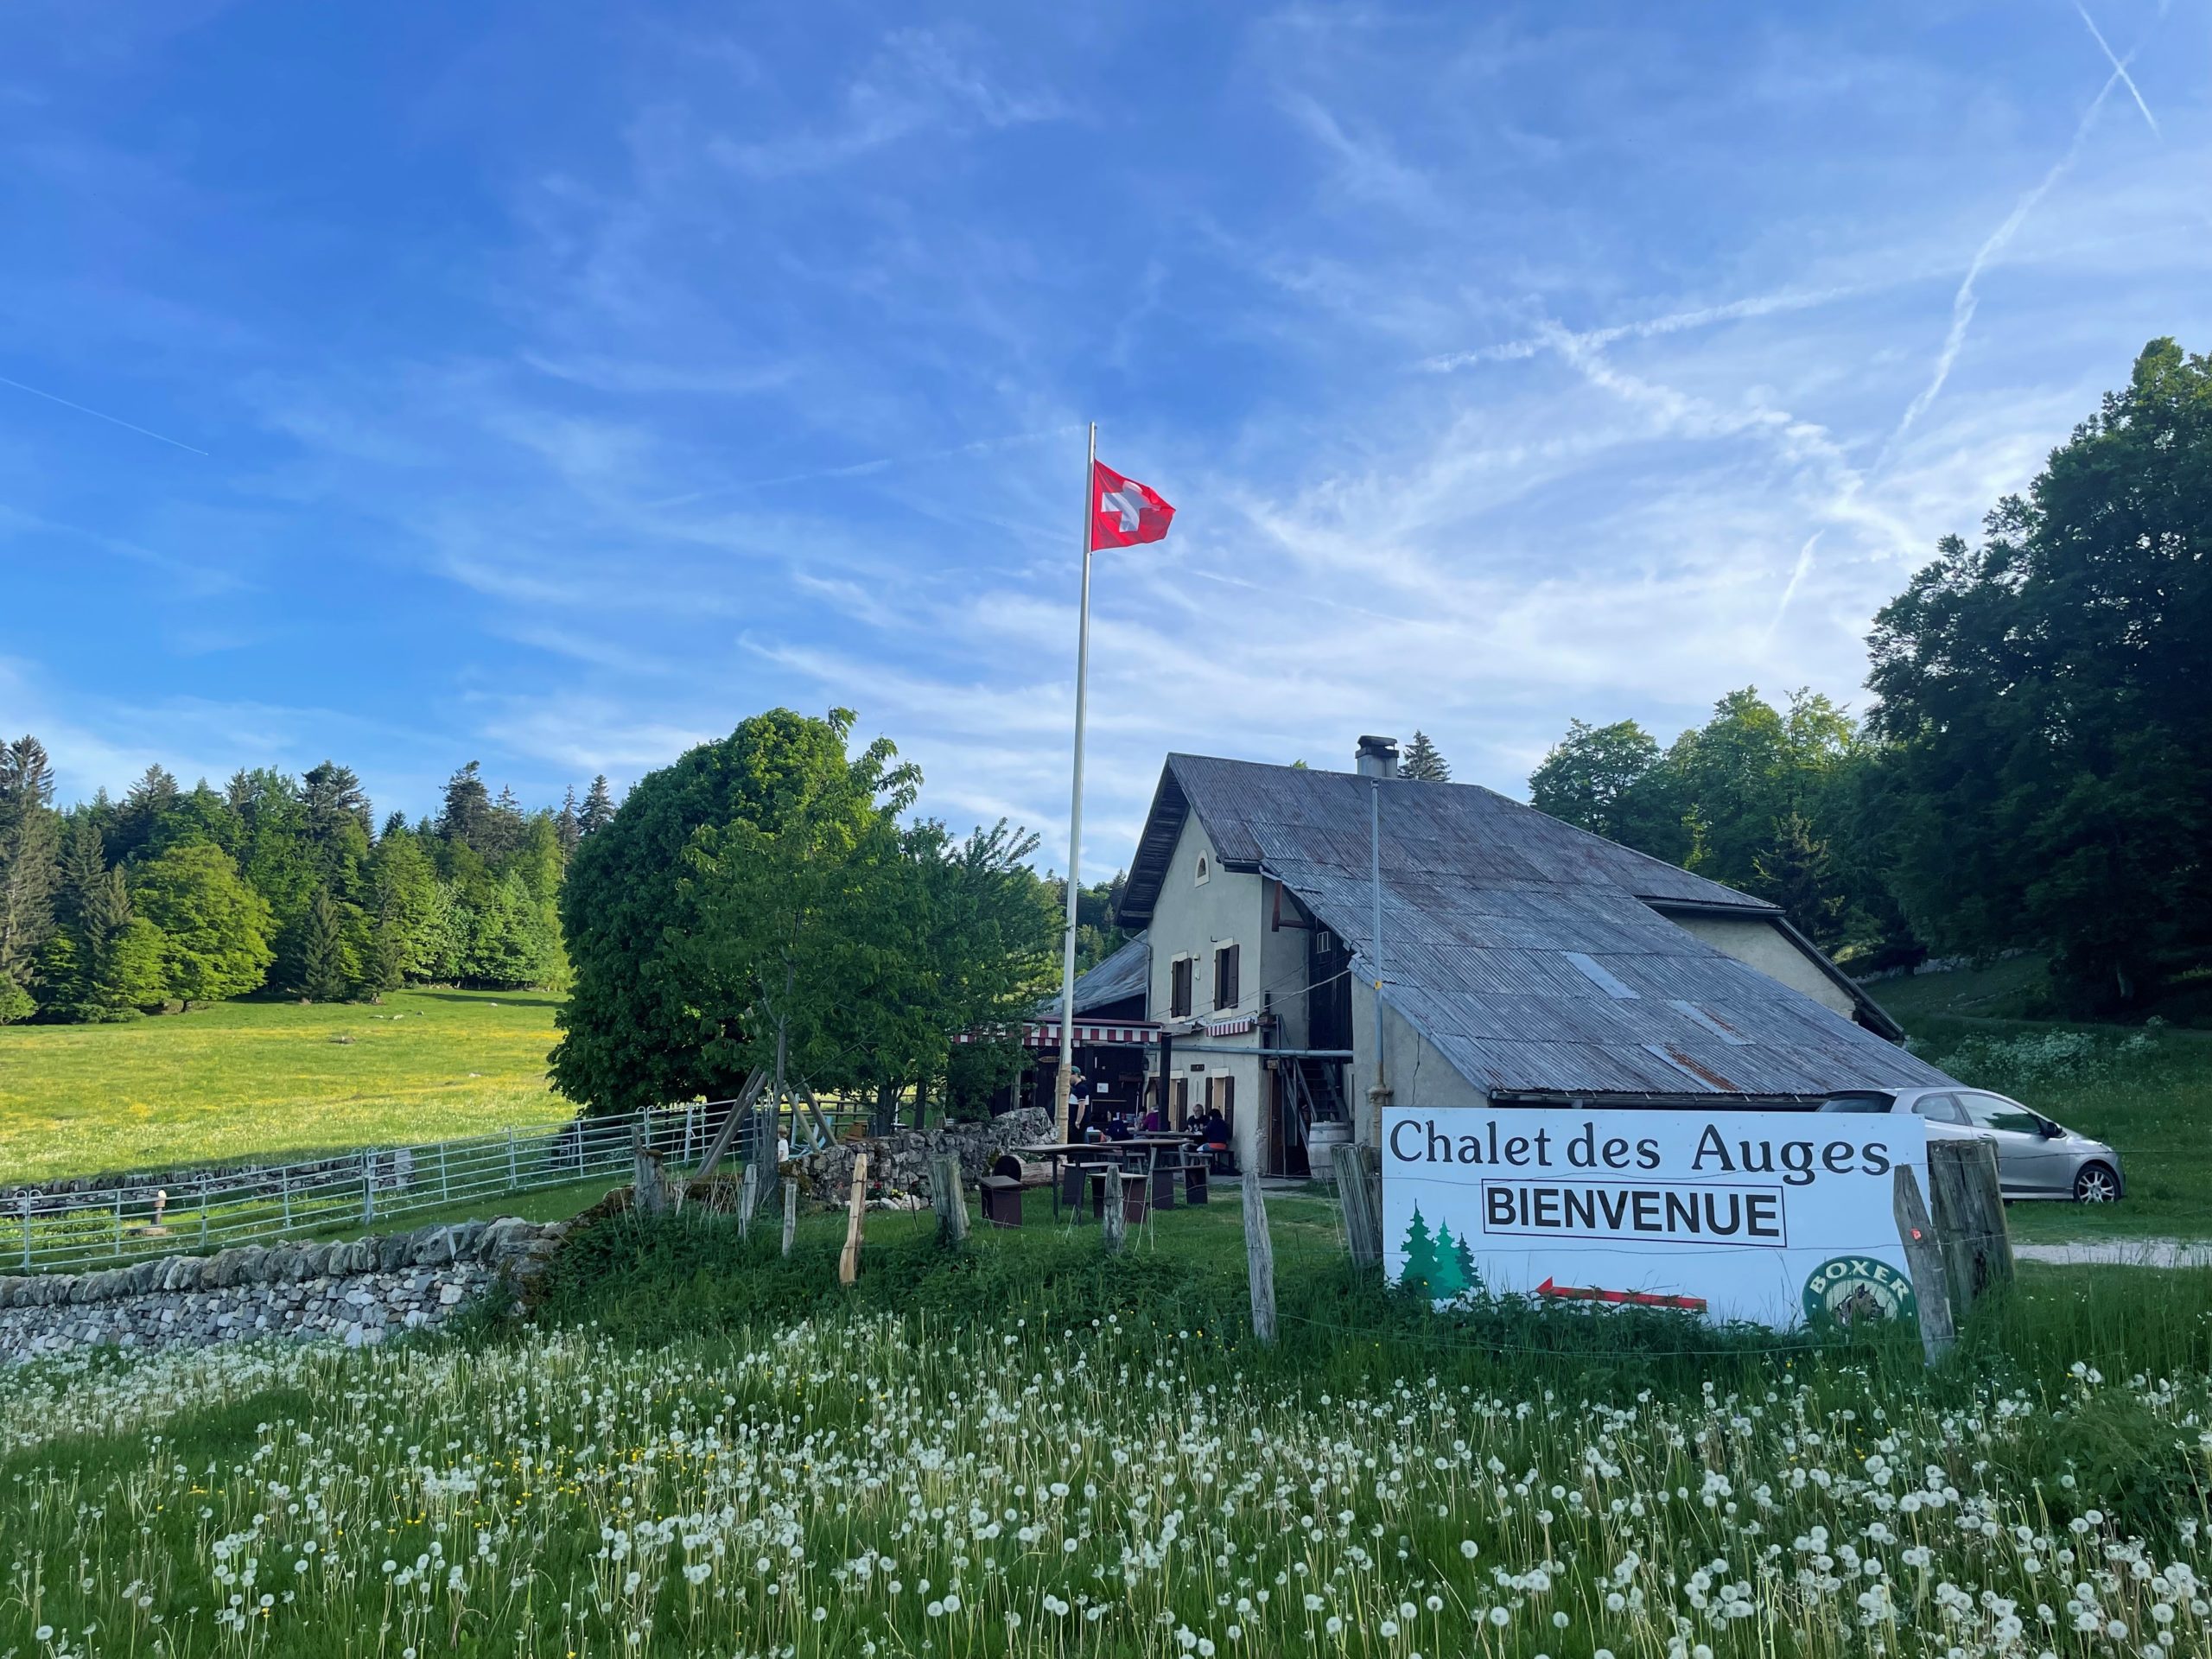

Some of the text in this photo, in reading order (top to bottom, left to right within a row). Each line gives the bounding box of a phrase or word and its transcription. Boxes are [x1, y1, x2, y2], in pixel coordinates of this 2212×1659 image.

[1389, 1119, 1890, 1186] Chalet des Auges
[1487, 1186, 1780, 1237] BIENVENUE
[1809, 1260, 1910, 1302] BOXER
